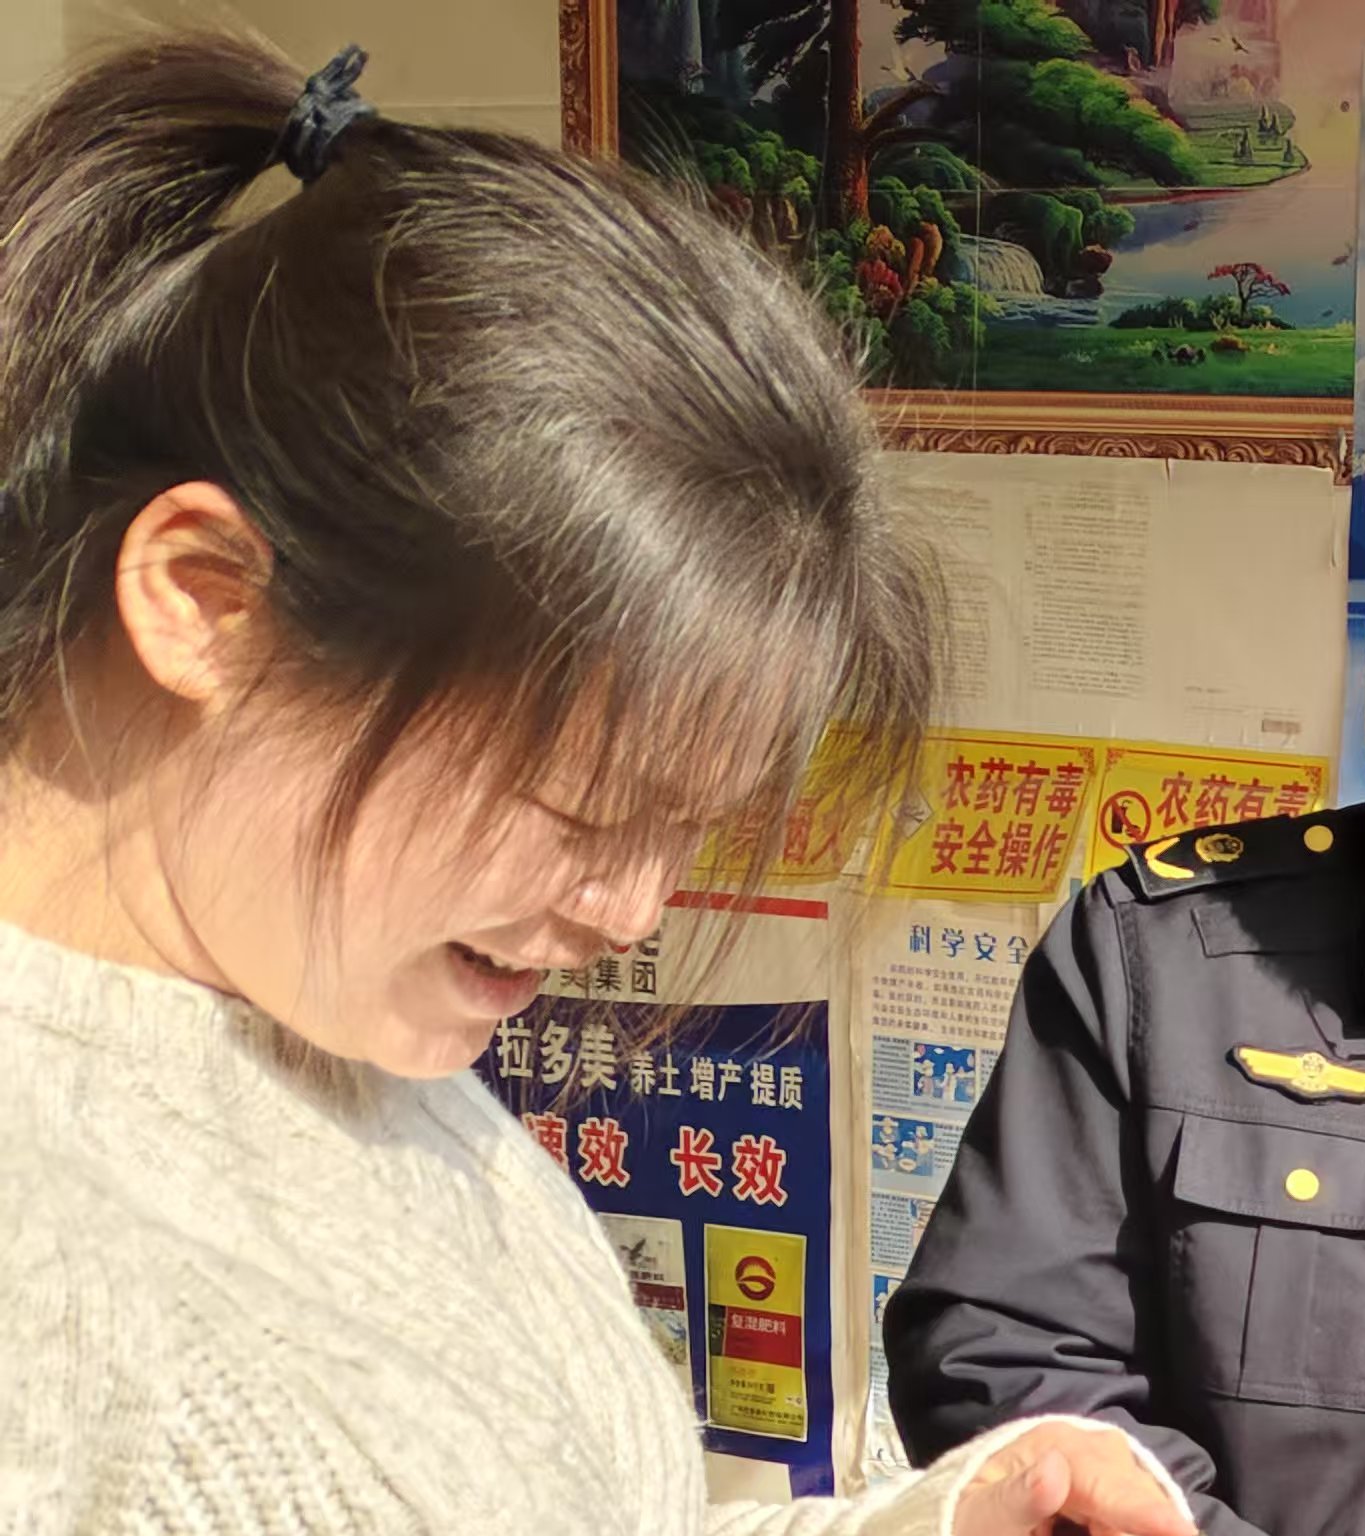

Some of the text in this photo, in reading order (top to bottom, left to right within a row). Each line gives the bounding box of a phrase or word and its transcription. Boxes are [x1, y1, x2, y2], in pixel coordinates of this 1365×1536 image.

[941, 756, 1084, 820] 农药有毒
[930, 818, 1067, 880] 安全操作
[496, 1018, 803, 1110] 拉多美 养土 增产 提质
[671, 1126, 788, 1206] 长效
